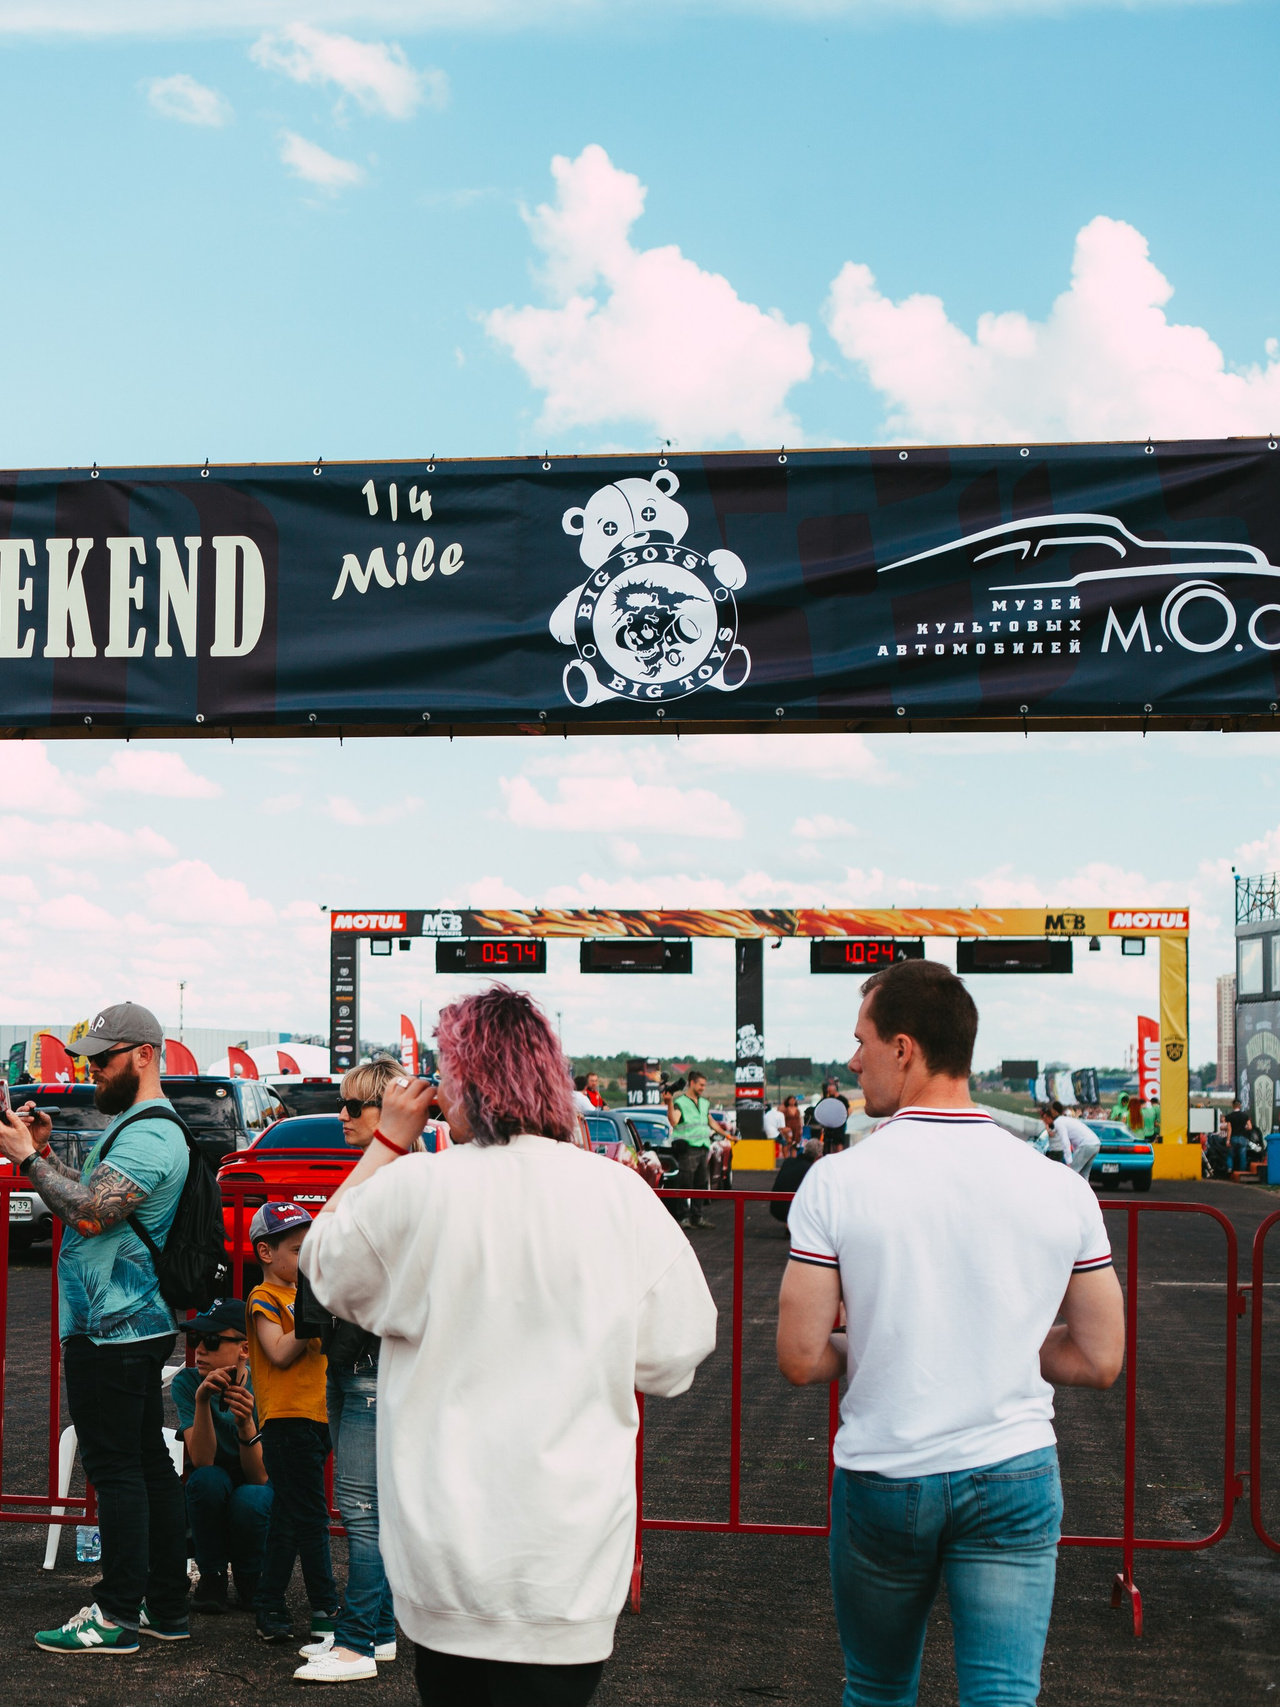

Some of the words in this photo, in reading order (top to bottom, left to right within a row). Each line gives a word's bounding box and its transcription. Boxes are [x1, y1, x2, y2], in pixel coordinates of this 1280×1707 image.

[331, 536, 465, 601] Mile
[577, 570, 611, 620] BIG
[991, 595, 1082, 612] МУЗЕЙ
[916, 619, 1082, 636] КУЛЬТОВЫХ
[876, 639, 1082, 657] АВТОМОБИЛЕЙ
[608, 674, 664, 698] BIG
[678, 627, 734, 690] TOYS
[333, 914, 403, 929] MOTUL
[1111, 912, 1187, 928] MOTUL
[482, 943, 536, 963] 0.574
[845, 942, 894, 963] 1.024
[628, 1090, 644, 1104] 1/8
[647, 1089, 660, 1104] 1/8
